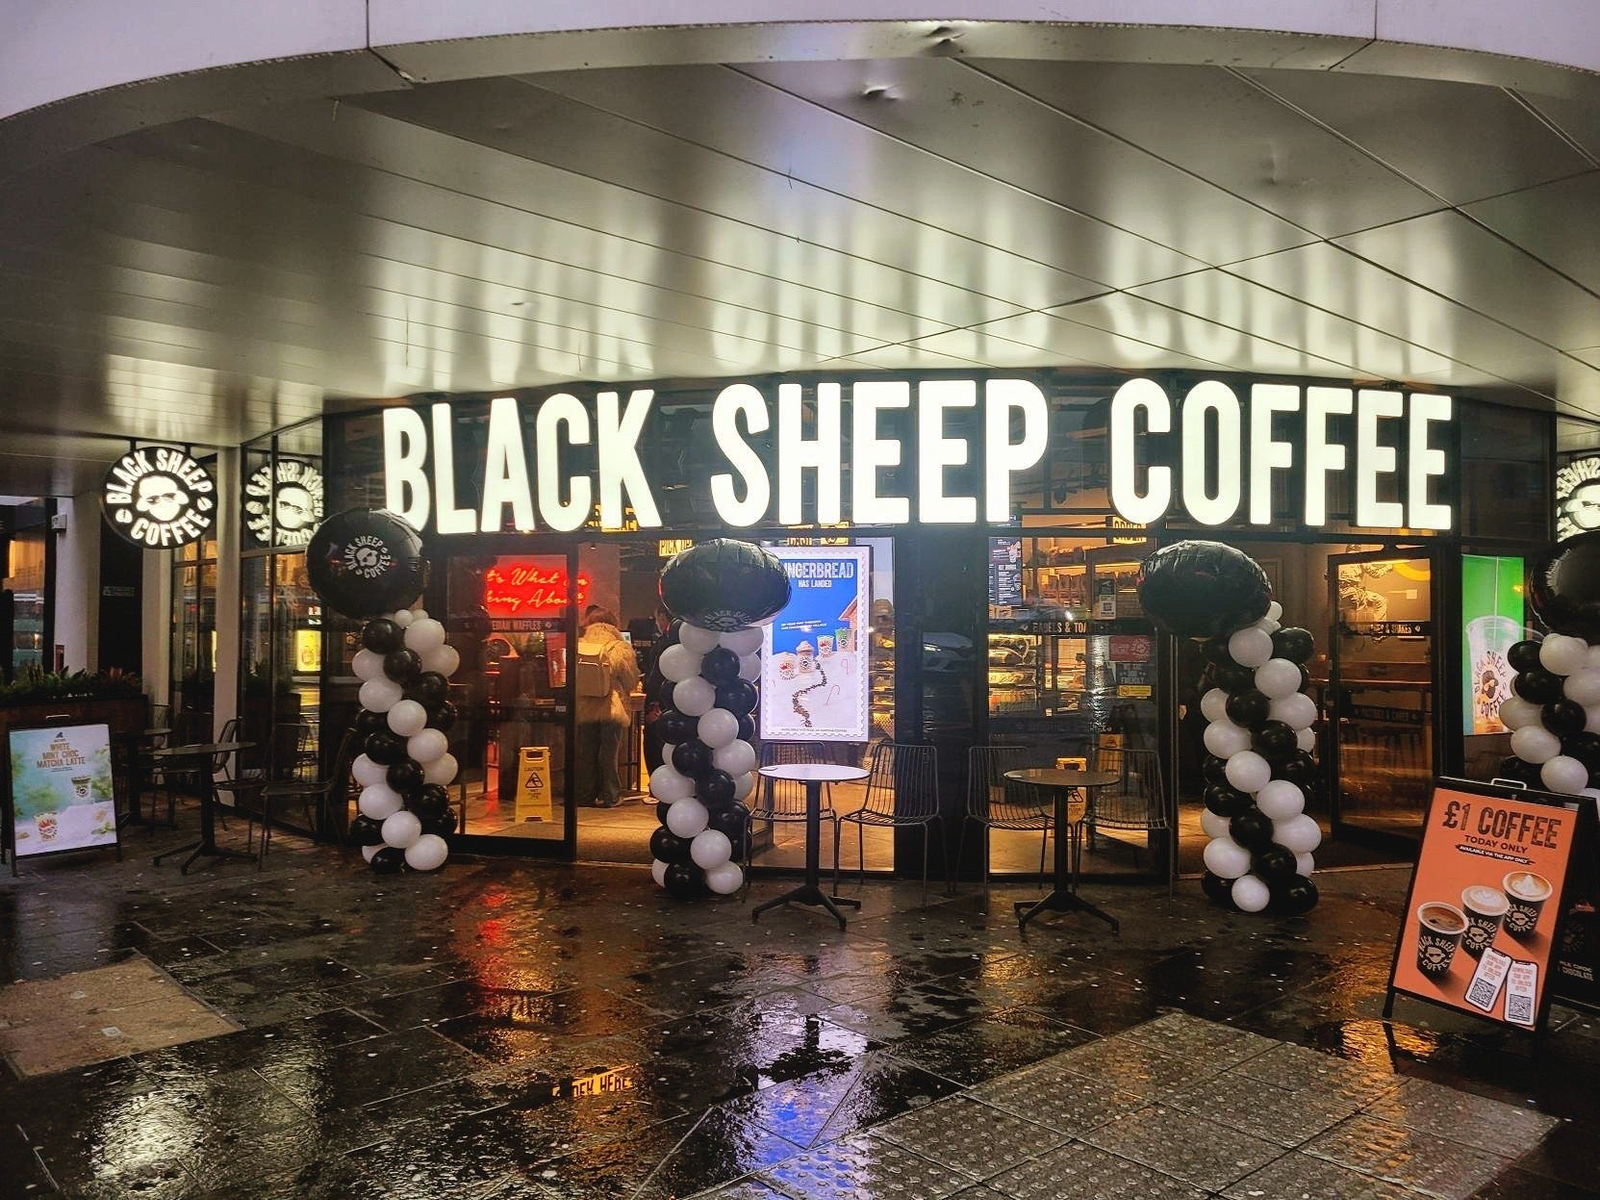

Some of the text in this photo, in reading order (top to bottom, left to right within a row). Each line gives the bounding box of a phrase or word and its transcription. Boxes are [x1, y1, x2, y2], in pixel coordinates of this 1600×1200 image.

[383, 378, 1451, 534] BLACK SHEEP COFFEE
[106, 448, 213, 504] BLACK SHEEP
[130, 507, 211, 546] COFFEE
[344, 535, 383, 570] BLACK SHEEP
[364, 554, 391, 578] COFFEE
[511, 567, 559, 585] What
[783, 562, 854, 578] INGERBREAD
[1064, 622, 1071, 633] &
[37, 757, 85, 768] MATCHA LATTE
[1442, 801, 1561, 849] £1 COFFEE
[1459, 846, 1485, 855] AVAILABLE
[1465, 835, 1528, 854] TODAY ONLY
